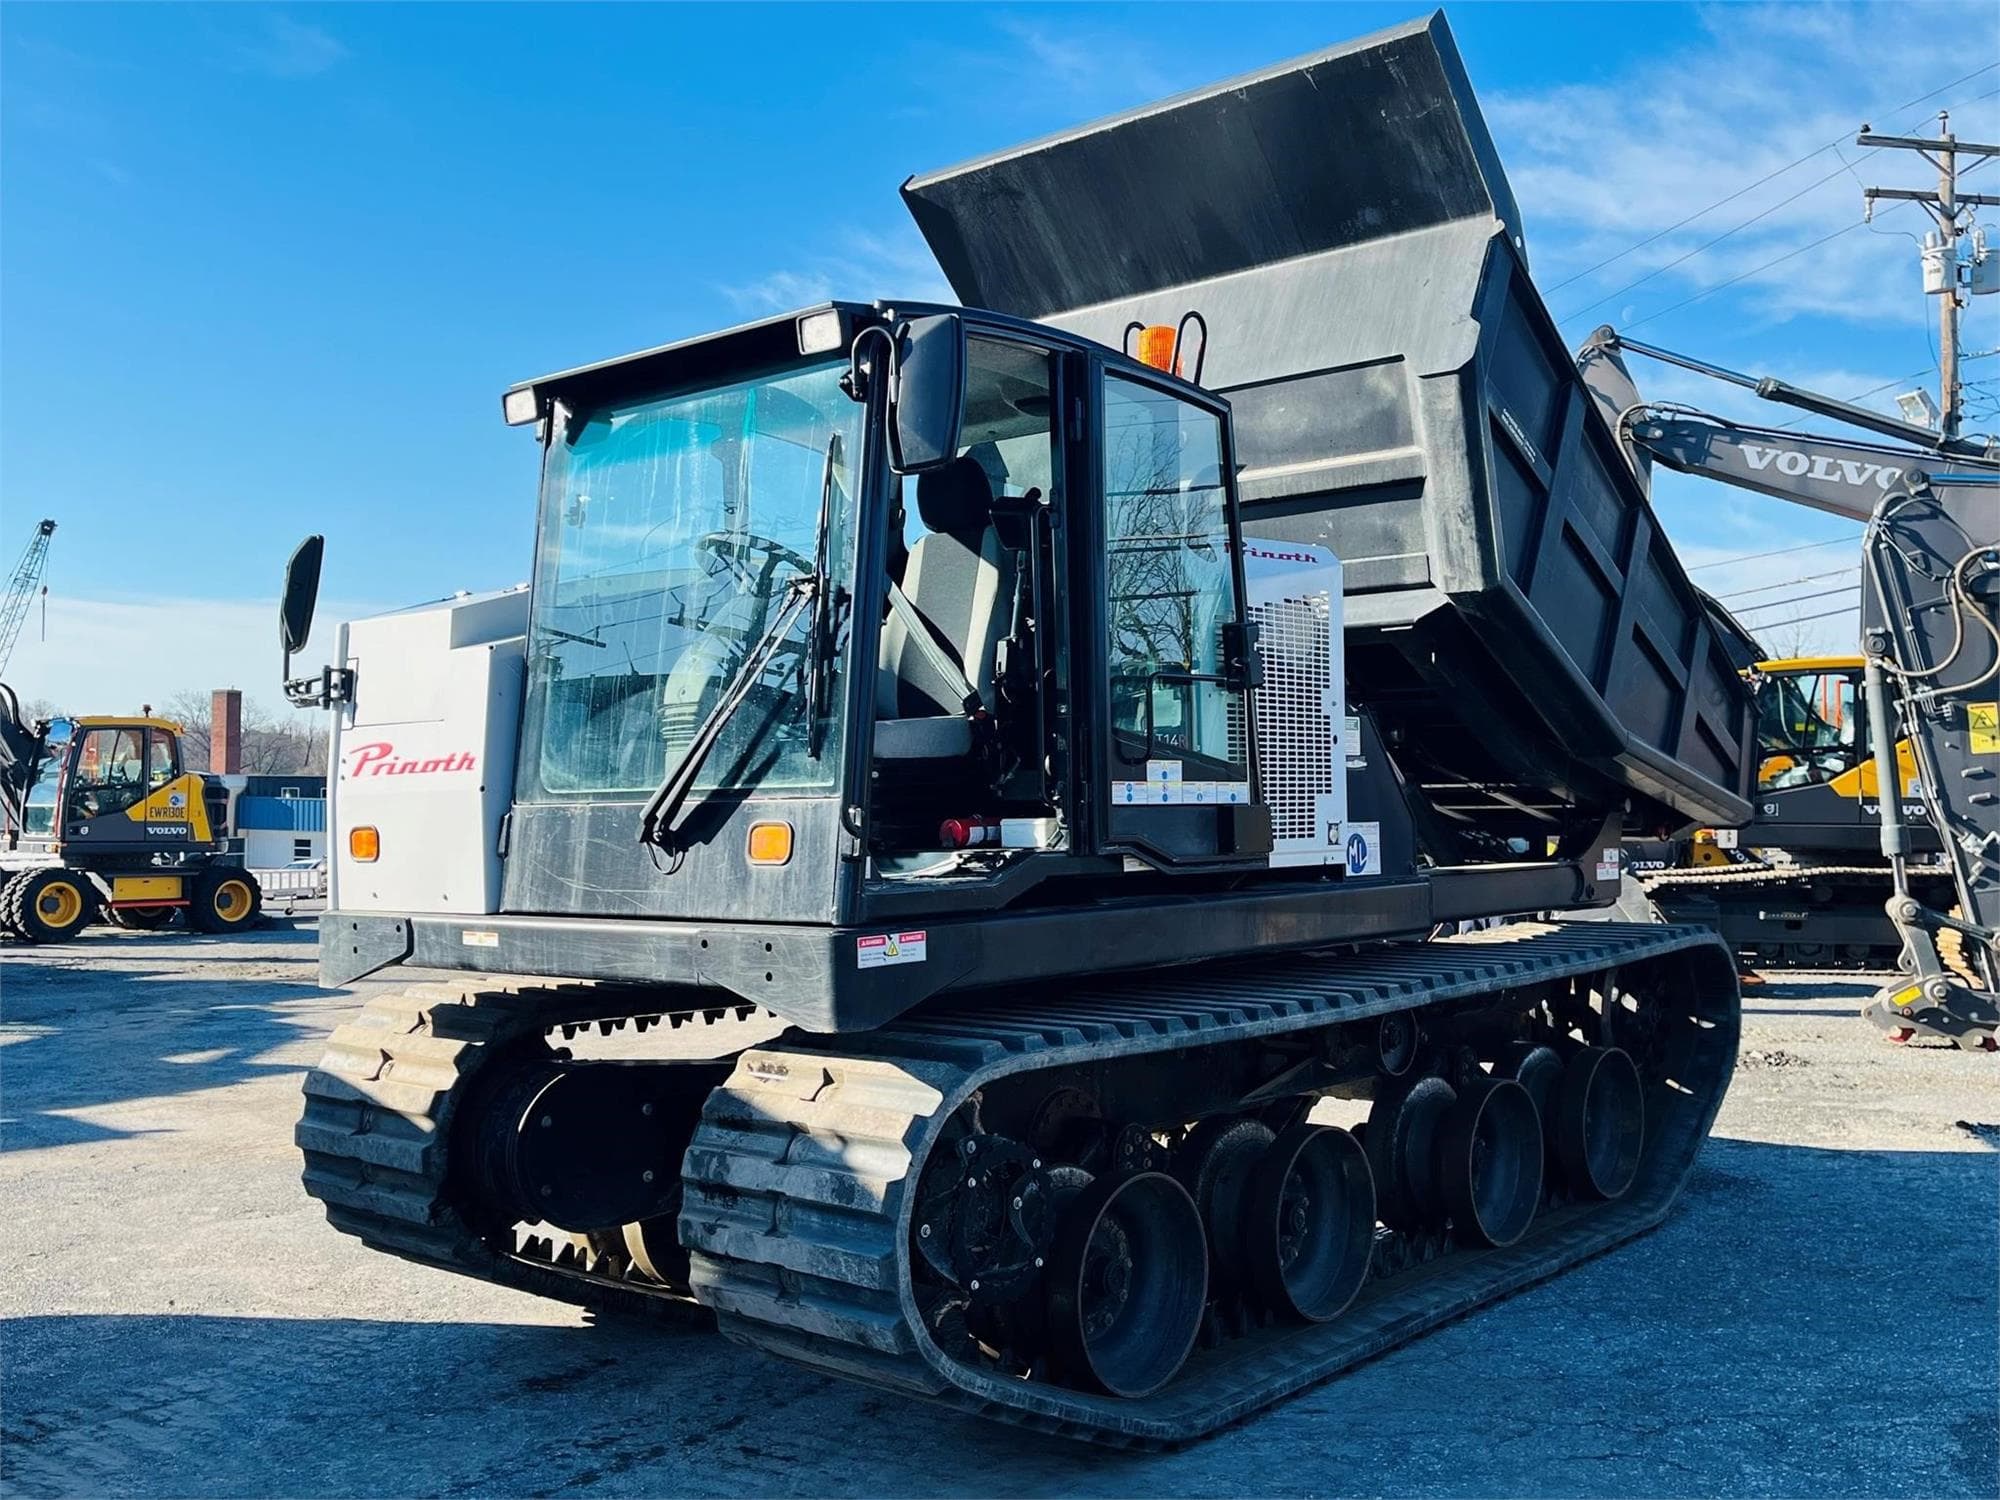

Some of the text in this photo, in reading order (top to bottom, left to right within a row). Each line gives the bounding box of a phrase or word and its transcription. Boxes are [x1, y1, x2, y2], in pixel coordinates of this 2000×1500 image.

[1738, 444, 1903, 491] VOLVO
[349, 742, 476, 777] Prinoth
[149, 806, 185, 819] EWR130E
[1863, 804, 1927, 816] VVO
[147, 826, 187, 835] VOLVO
[1631, 860, 1666, 870] OLVO
